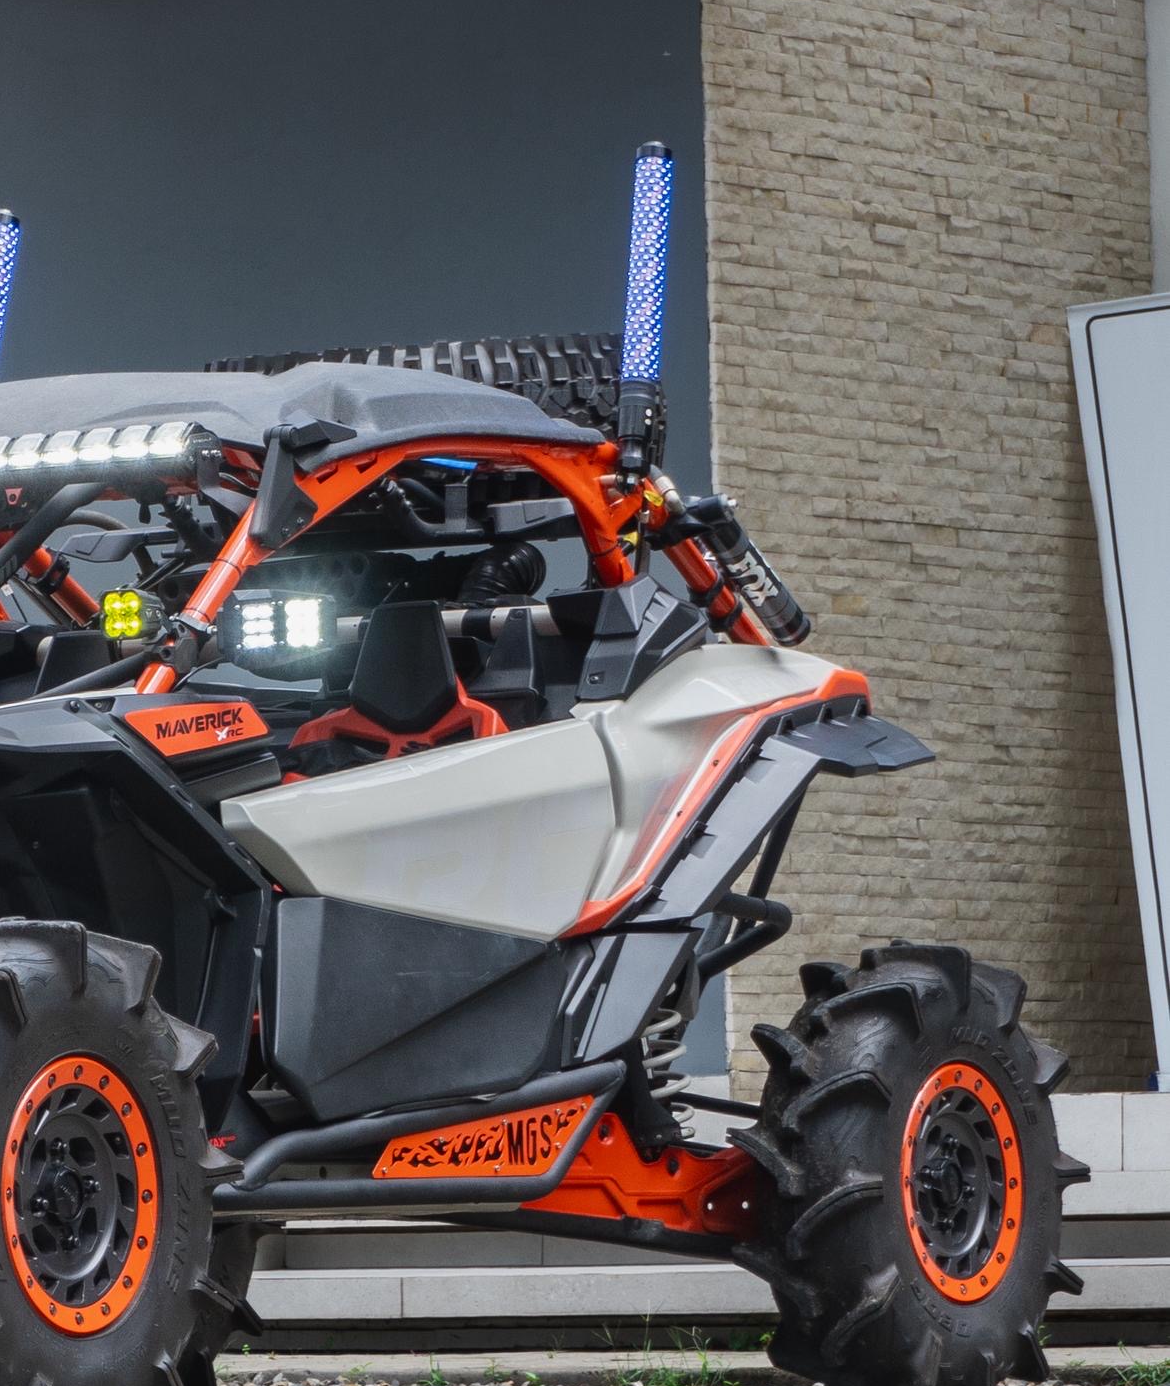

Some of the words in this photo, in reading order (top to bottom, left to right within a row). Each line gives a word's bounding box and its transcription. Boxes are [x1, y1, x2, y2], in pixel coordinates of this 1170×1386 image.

[726, 551, 779, 607] FOX
[156, 707, 243, 739] MAVERICK
[507, 1115, 552, 1166] MGS
